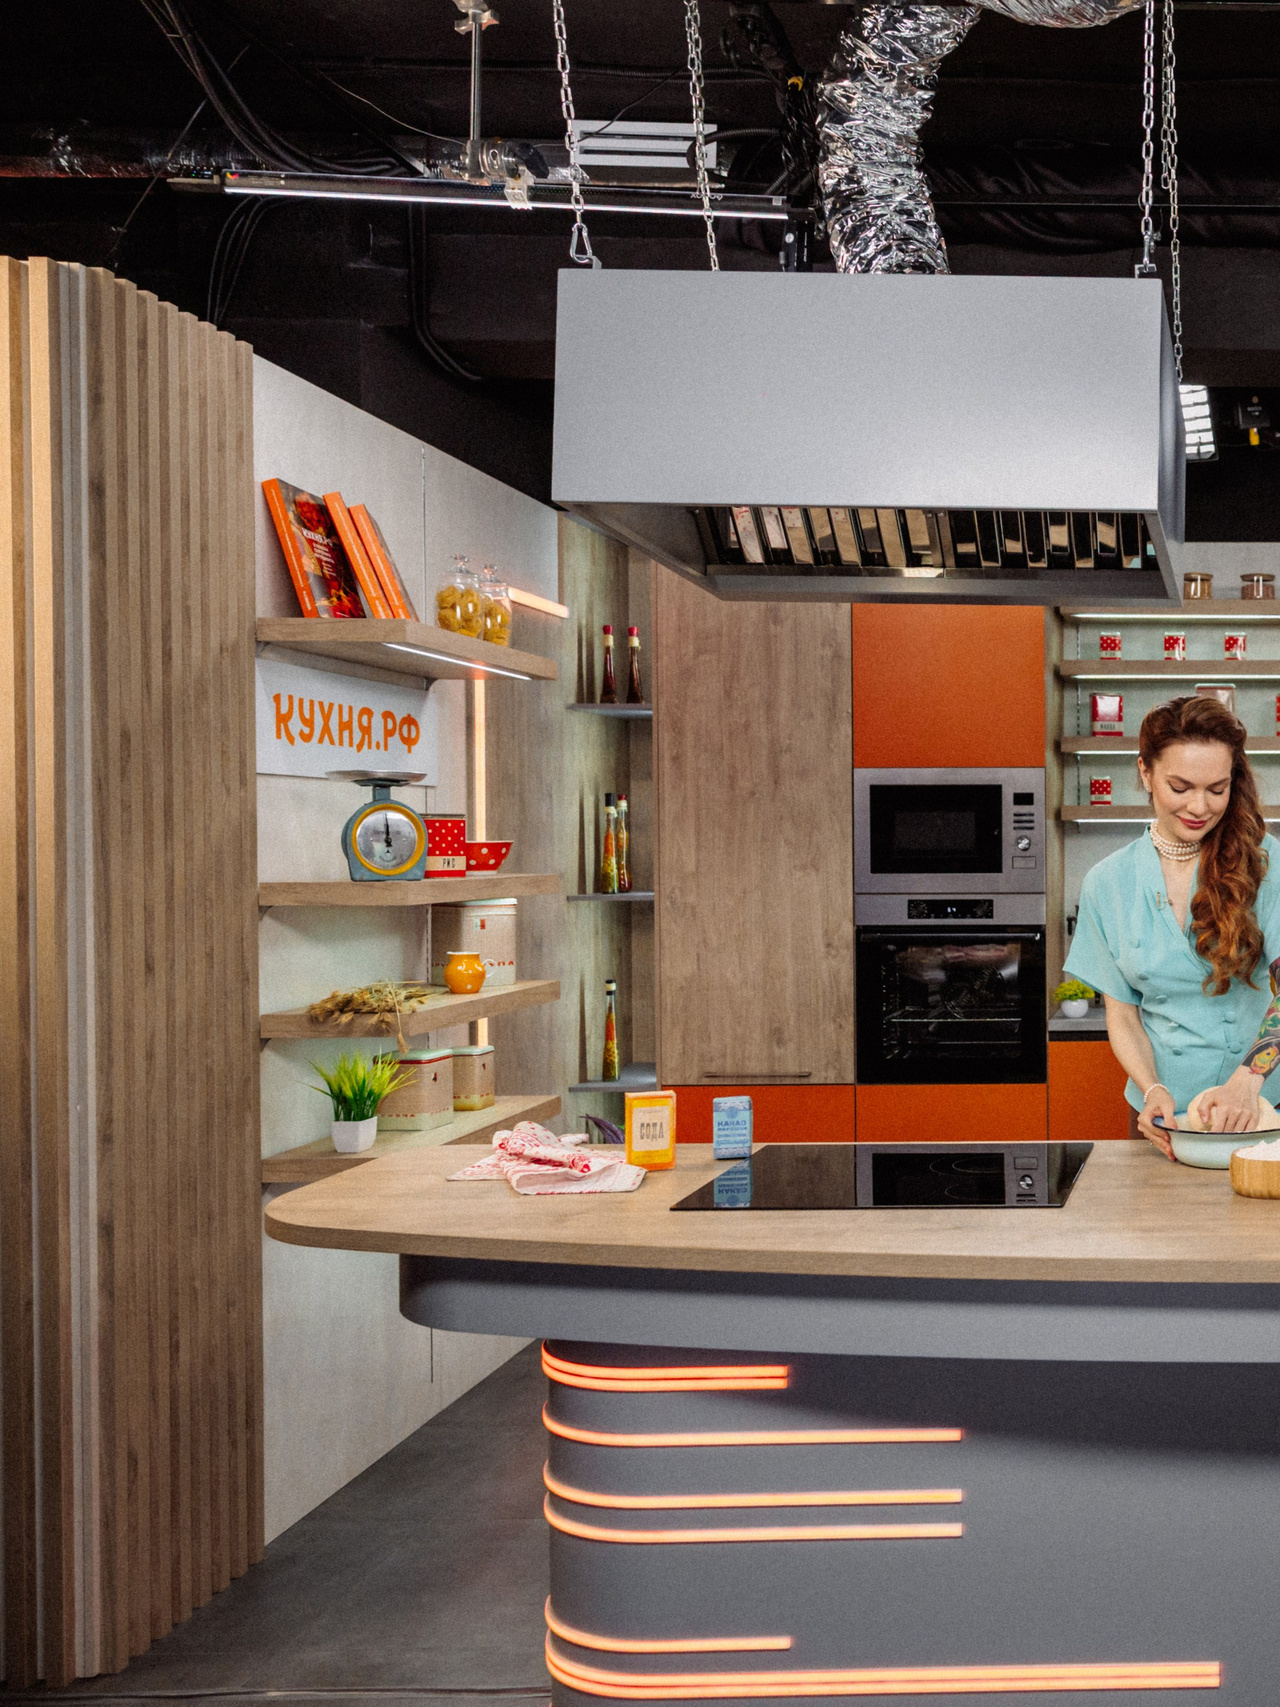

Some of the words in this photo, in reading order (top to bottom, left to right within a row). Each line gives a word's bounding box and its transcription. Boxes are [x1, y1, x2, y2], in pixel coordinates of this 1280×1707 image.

[272, 693, 420, 754] КУХНЯ.РФ
[442, 858, 456, 868] РИС
[640, 1122, 664, 1141] СОДА
